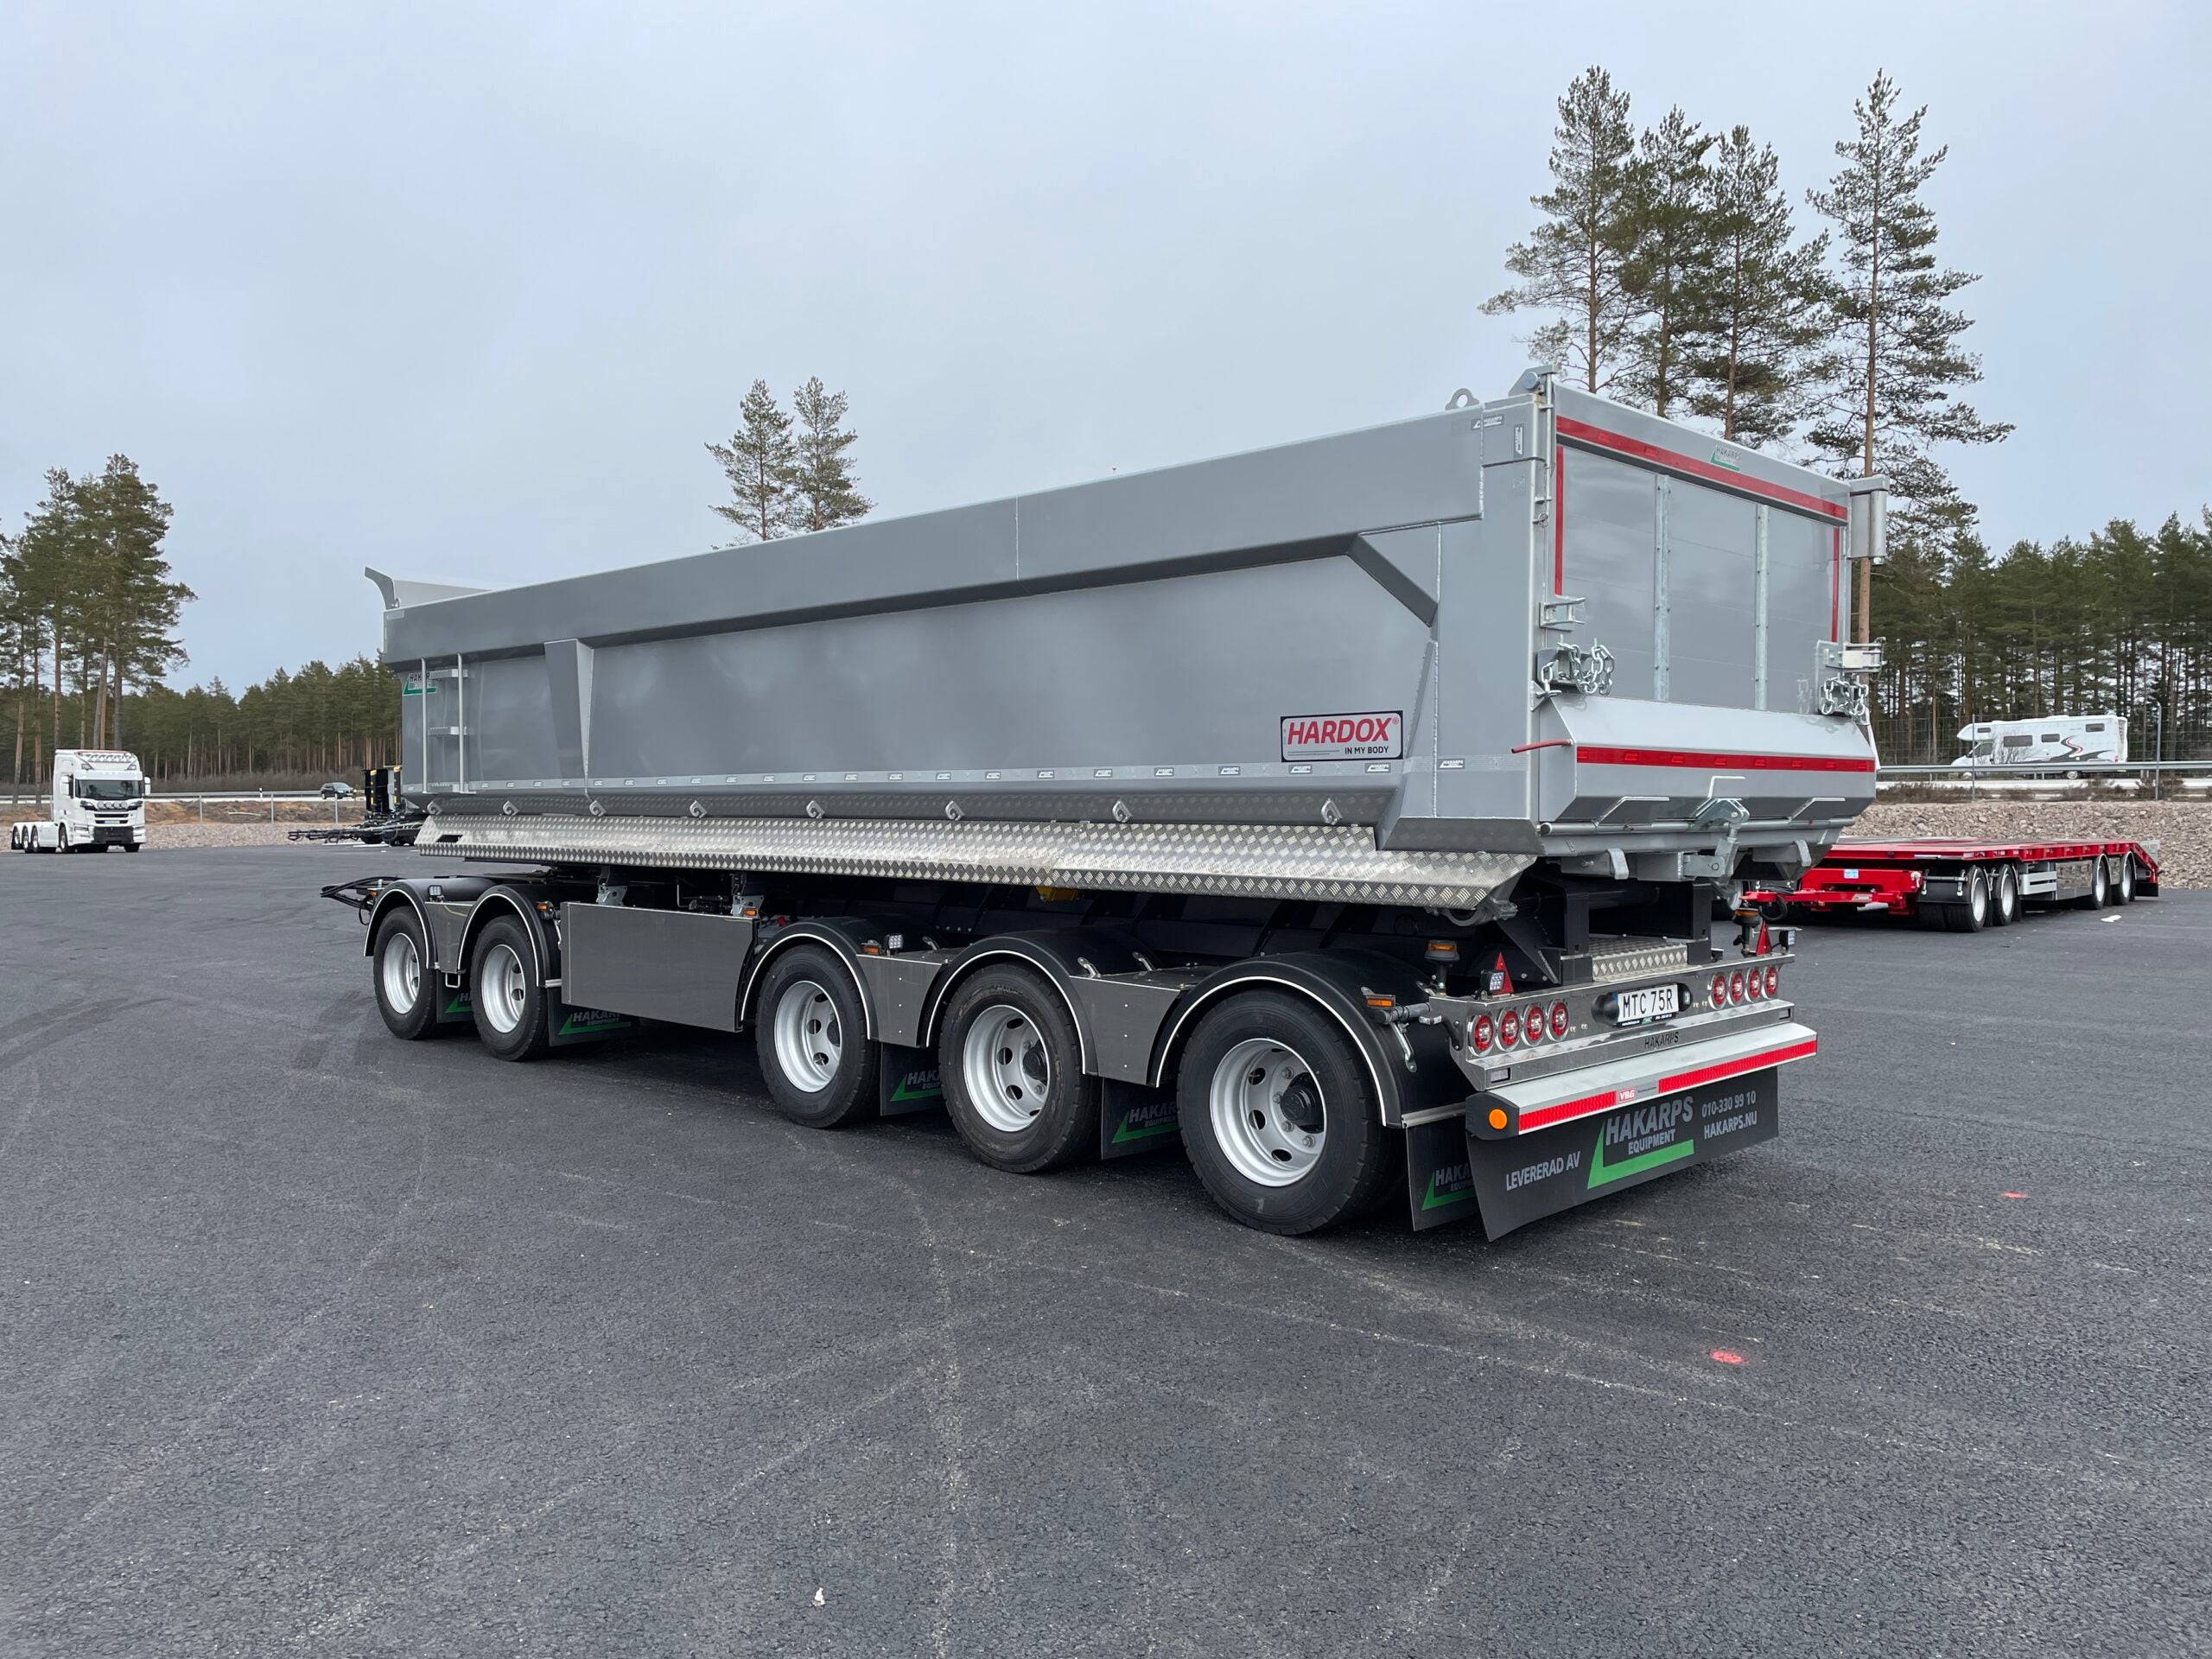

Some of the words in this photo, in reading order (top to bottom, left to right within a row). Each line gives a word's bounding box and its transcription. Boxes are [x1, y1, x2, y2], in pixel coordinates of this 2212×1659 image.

[1287, 717, 1392, 745] HARDOX
[1368, 746, 1389, 754] BODY
[1623, 993, 1647, 1018] MTC
[1650, 988, 1673, 1013] 75R
[1644, 1032, 1679, 1049] HAKARPS
[1619, 1090, 1636, 1101] VBG
[1701, 1098, 1733, 1117] 010-330
[1734, 1095, 1745, 1109] 99
[1746, 1090, 1757, 1105] 10
[1605, 1096, 1694, 1146] HAKARPS
[1704, 1110, 1758, 1140] HAKARPS.NU
[1628, 1129, 1676, 1155] EQUIPMENT
[1506, 1157, 1564, 1192] LEVERERAD
[1566, 1151, 1581, 1171] AV
